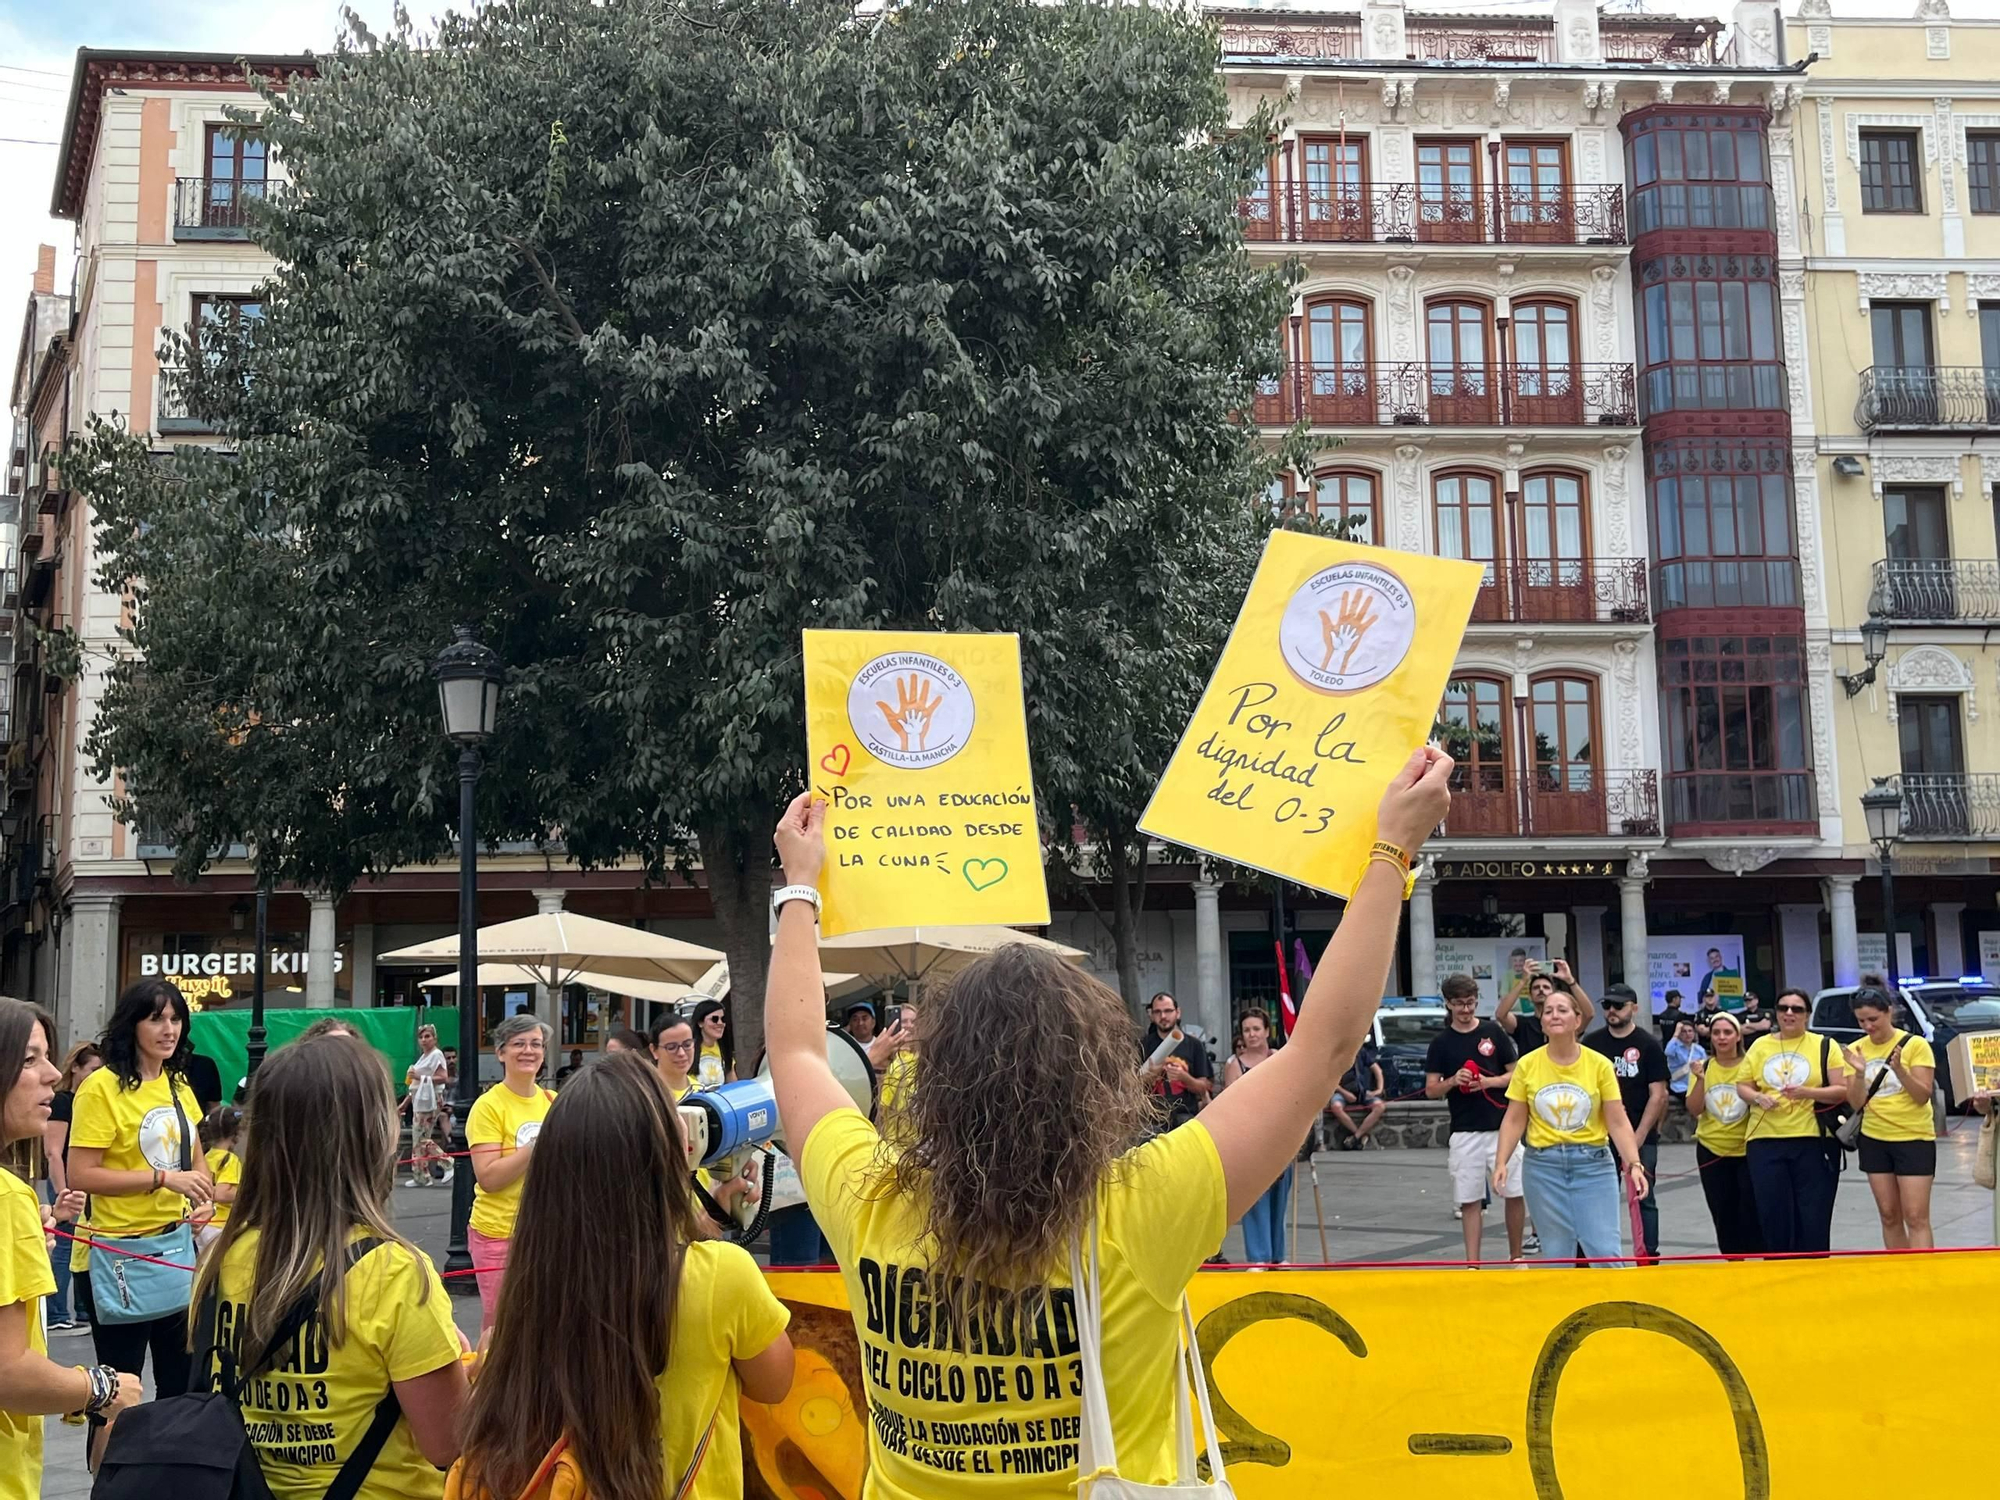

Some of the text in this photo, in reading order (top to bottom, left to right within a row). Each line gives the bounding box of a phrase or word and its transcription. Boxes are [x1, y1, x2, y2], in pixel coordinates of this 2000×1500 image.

[1310, 570, 1408, 609] ESCUELAS INFANTILES 0-3
[858, 656, 962, 688] ESCUELAS INFANTILES 0-3
[1309, 670, 1344, 685] TOLEDO
[1228, 682, 1366, 764] Por la
[922, 743, 958, 761] MANCHA
[1197, 731, 1319, 788] dignidad
[831, 786, 1031, 810] POR UNA EDUCACIÓN
[1207, 779, 1335, 834] del 0-3
[833, 823, 1023, 840] DE CALIDAD DESDE
[840, 854, 930, 867] LA CUNA
[1460, 862, 1536, 877] ADOLFO
[140, 953, 256, 976] BURGER
[1445, 953, 1474, 963] cajero
[859, 1257, 1082, 1358] DIGNIDAD
[256, 1379, 274, 1411] DE
[295, 1382, 309, 1411] A
[313, 1380, 329, 1410] 3
[898, 1357, 966, 1404] CICLO
[974, 1365, 1008, 1404] DE
[1043, 1362, 1062, 1400] A
[286, 1423, 301, 1442] SE
[304, 1422, 336, 1441] DEBE
[909, 1417, 928, 1442] LA
[931, 1416, 1021, 1446] EDUCACIÓN
[1025, 1420, 1046, 1442] SE
[1050, 1416, 1081, 1440] DEB
[912, 1444, 966, 1473] DESDE
[973, 1450, 994, 1473] EL
[1000, 1443, 1080, 1474] PRINCIPI
